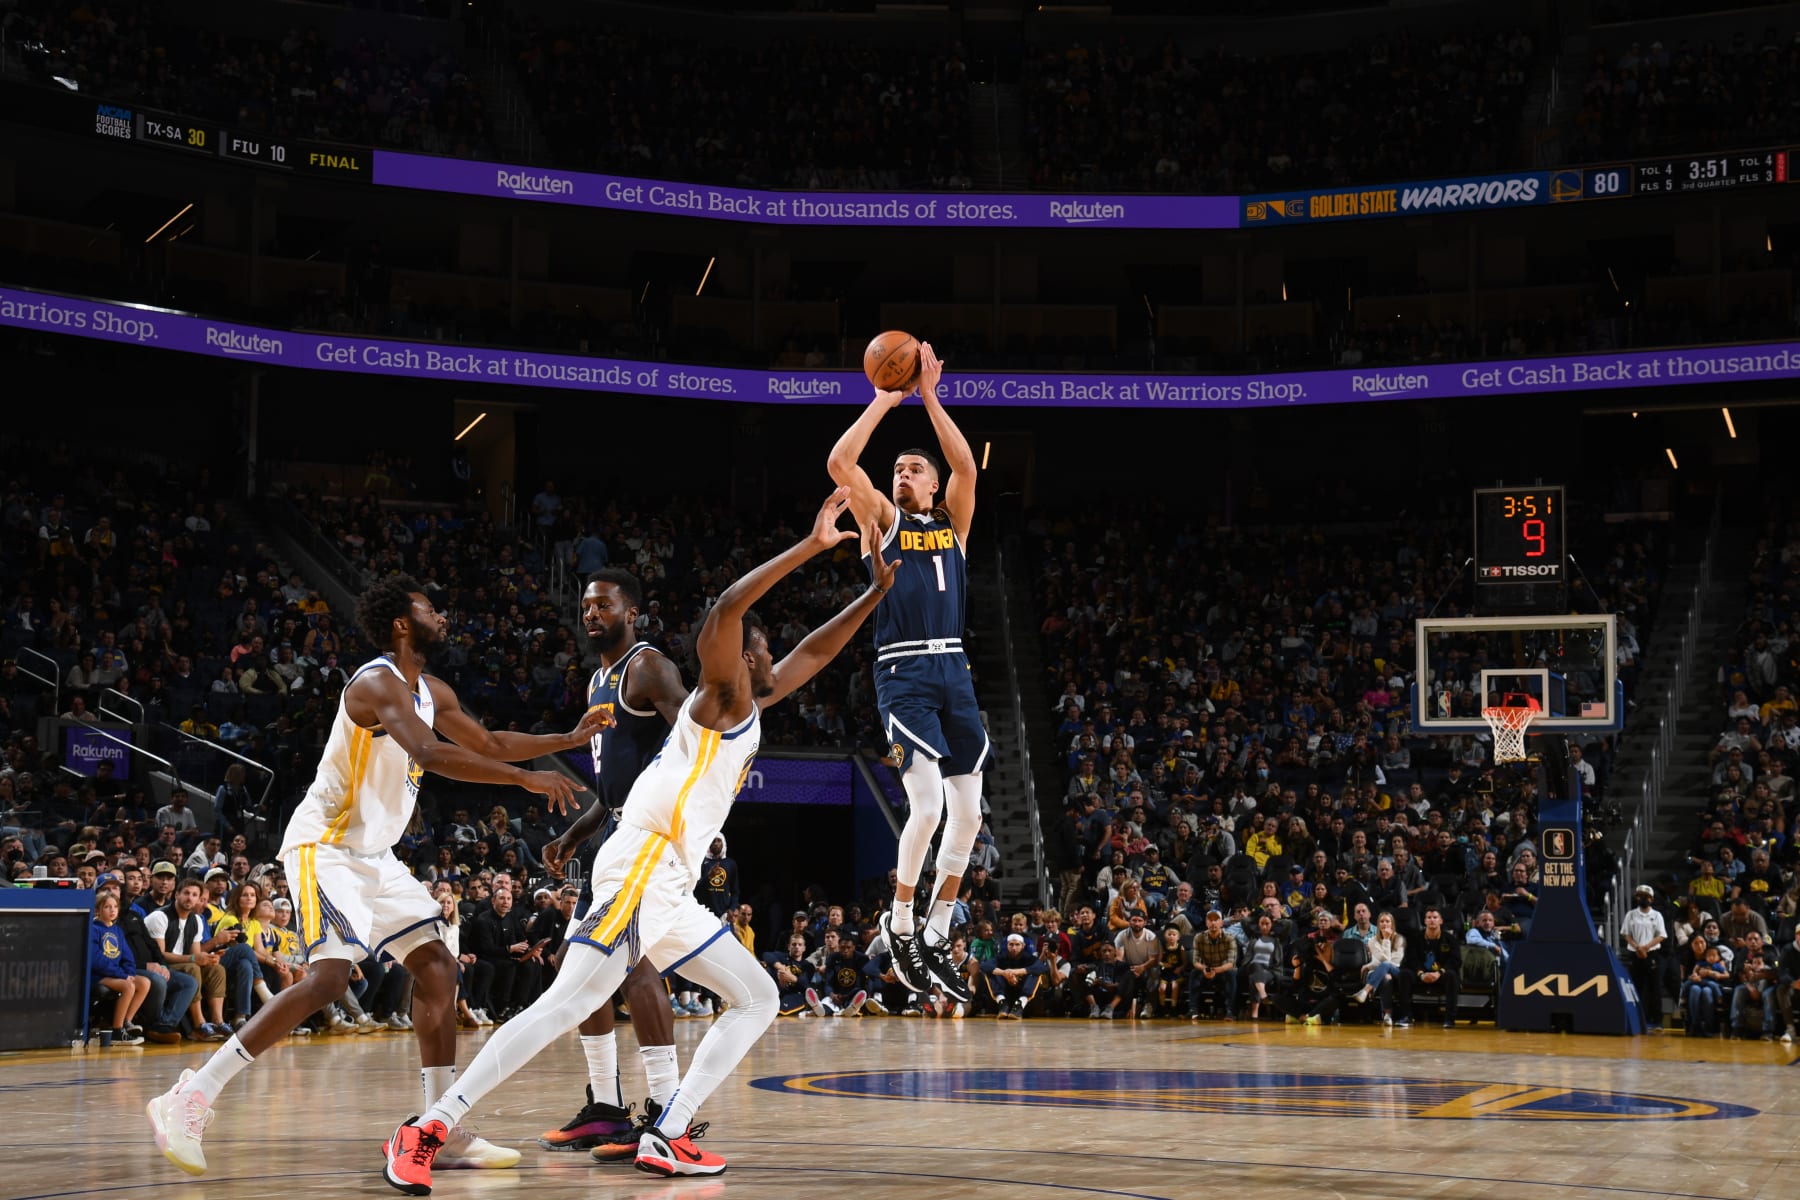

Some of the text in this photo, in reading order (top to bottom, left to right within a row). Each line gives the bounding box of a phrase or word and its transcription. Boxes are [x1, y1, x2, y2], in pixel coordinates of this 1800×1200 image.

[96, 114, 131, 128] FOOTBALL
[96, 122, 131, 139] SCORES
[146, 121, 206, 147] TX-SA 30
[232, 139, 286, 162] FIU 10
[309, 152, 360, 170] FINAL
[1739, 154, 1772, 167] TOL 4
[1640, 164, 1672, 176] TOL 4
[1689, 158, 1728, 180] 3:51
[1739, 170, 1773, 183] FLS 3
[497, 170, 573, 195] Rakuten
[1594, 172, 1620, 194] 80
[1640, 179, 1673, 192] FLS 5
[605, 182, 1018, 220] Get Cash Back at thousands of stores.
[1309, 177, 1540, 218] GOLDEN STATE WARRIORS
[1050, 200, 1124, 224] Rakuten
[0, 297, 159, 342] arriors Shop.
[206, 327, 283, 355] Rakuten
[316, 342, 737, 394] Get Cash Back at thousands of stores.
[1462, 350, 1800, 388] Get Cash Back at thousands
[768, 377, 841, 400] Rakuten
[953, 379, 997, 399] 10%
[1001, 380, 1056, 400] Cash
[1060, 381, 1114, 400] Back
[1119, 382, 1140, 401] at
[1145, 382, 1242, 401] Warriors
[1247, 380, 1307, 403] Shop.
[1352, 373, 1429, 397] Rakuten
[1503, 495, 1553, 518] 3:51
[1522, 519, 1546, 557] 9
[932, 555, 946, 592] 1
[1502, 564, 1559, 577] TISSOT
[72, 743, 124, 761] Rakuten
[1544, 862, 1574, 875] GET THE
[1543, 875, 1576, 888] NEW APP
[1513, 973, 1609, 998] KIA
